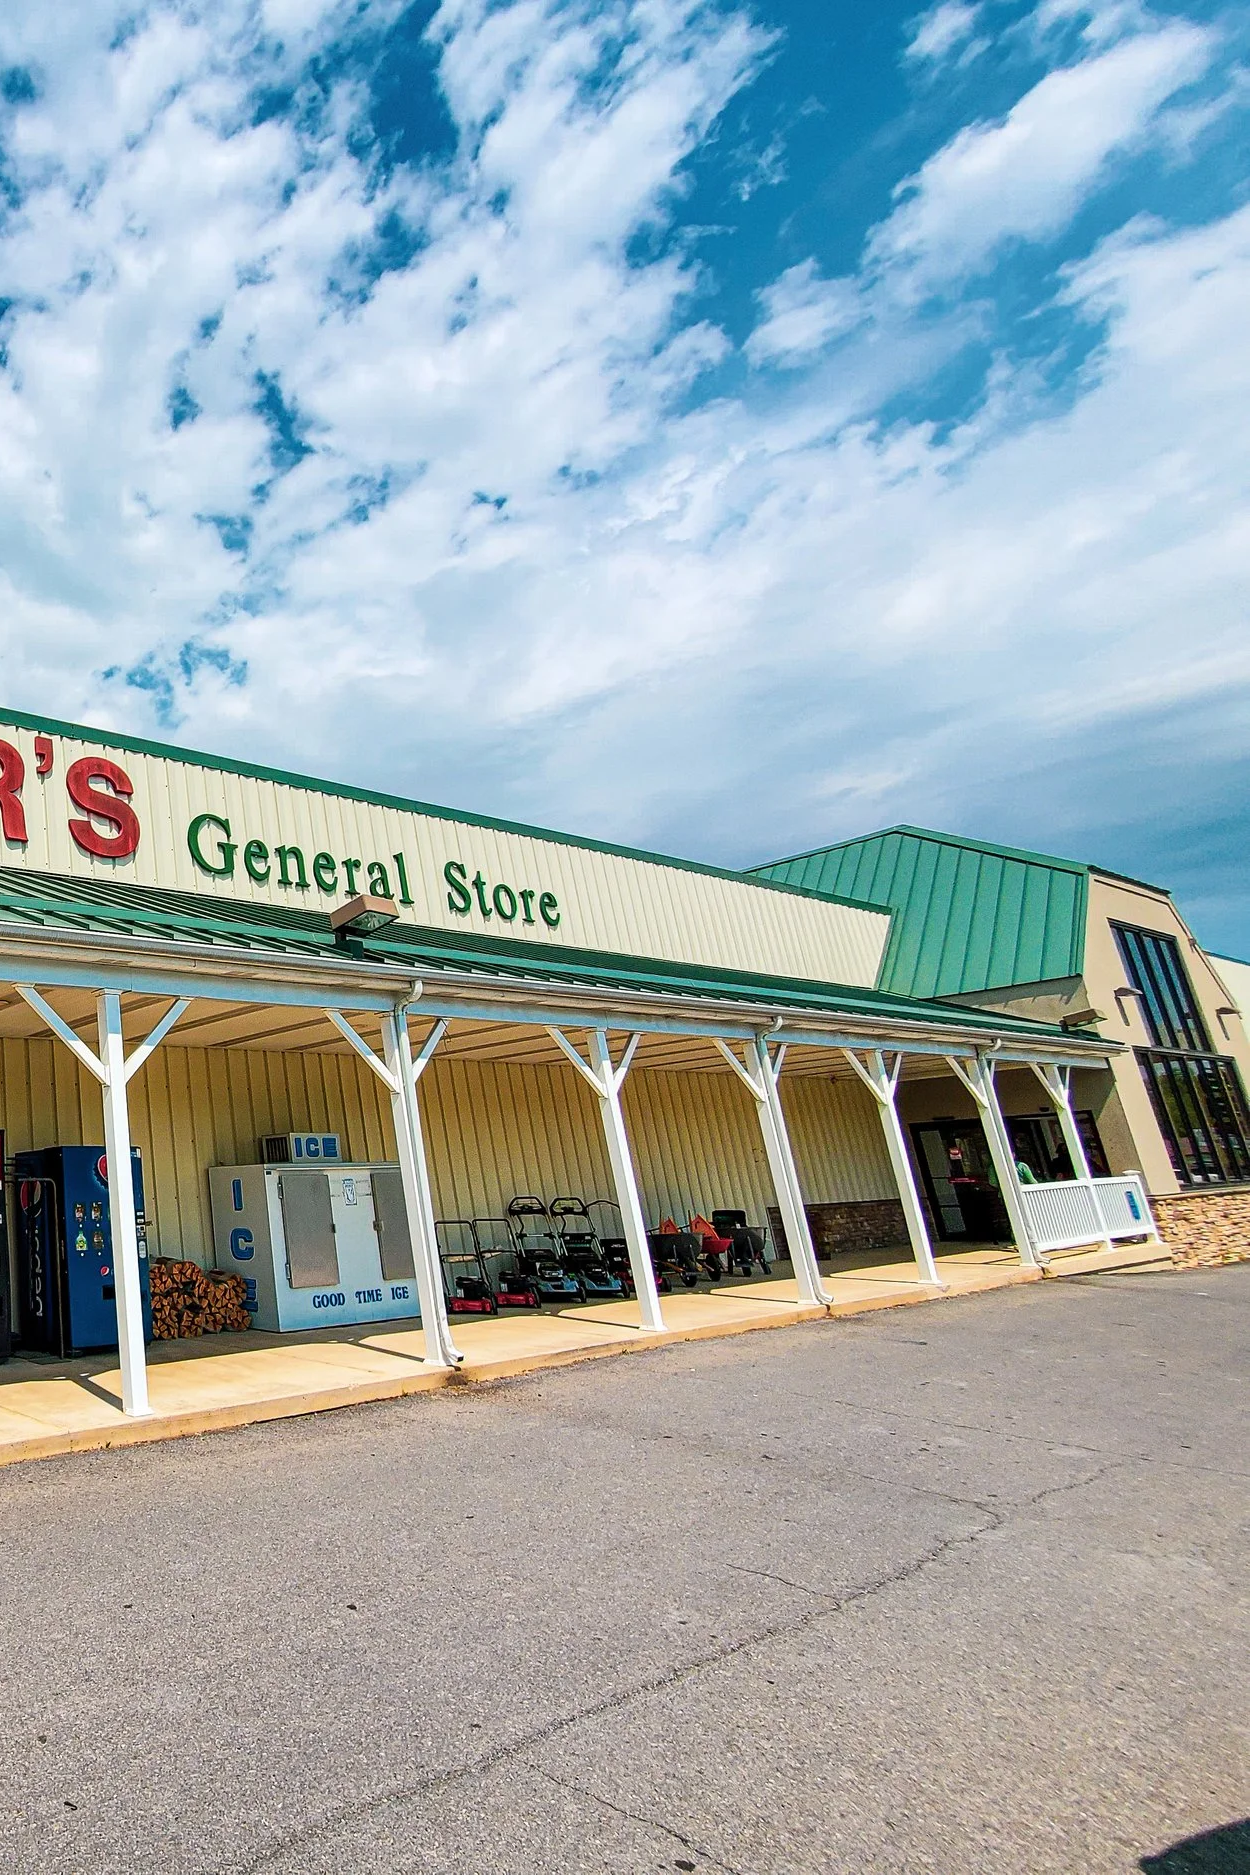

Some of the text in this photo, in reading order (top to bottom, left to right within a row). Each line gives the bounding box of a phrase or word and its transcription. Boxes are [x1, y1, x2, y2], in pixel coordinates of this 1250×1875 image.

[187, 813, 561, 926] General Store
[294, 1137, 338, 1158] ICE
[312, 1286, 409, 1309] GOOD TIME ICE
